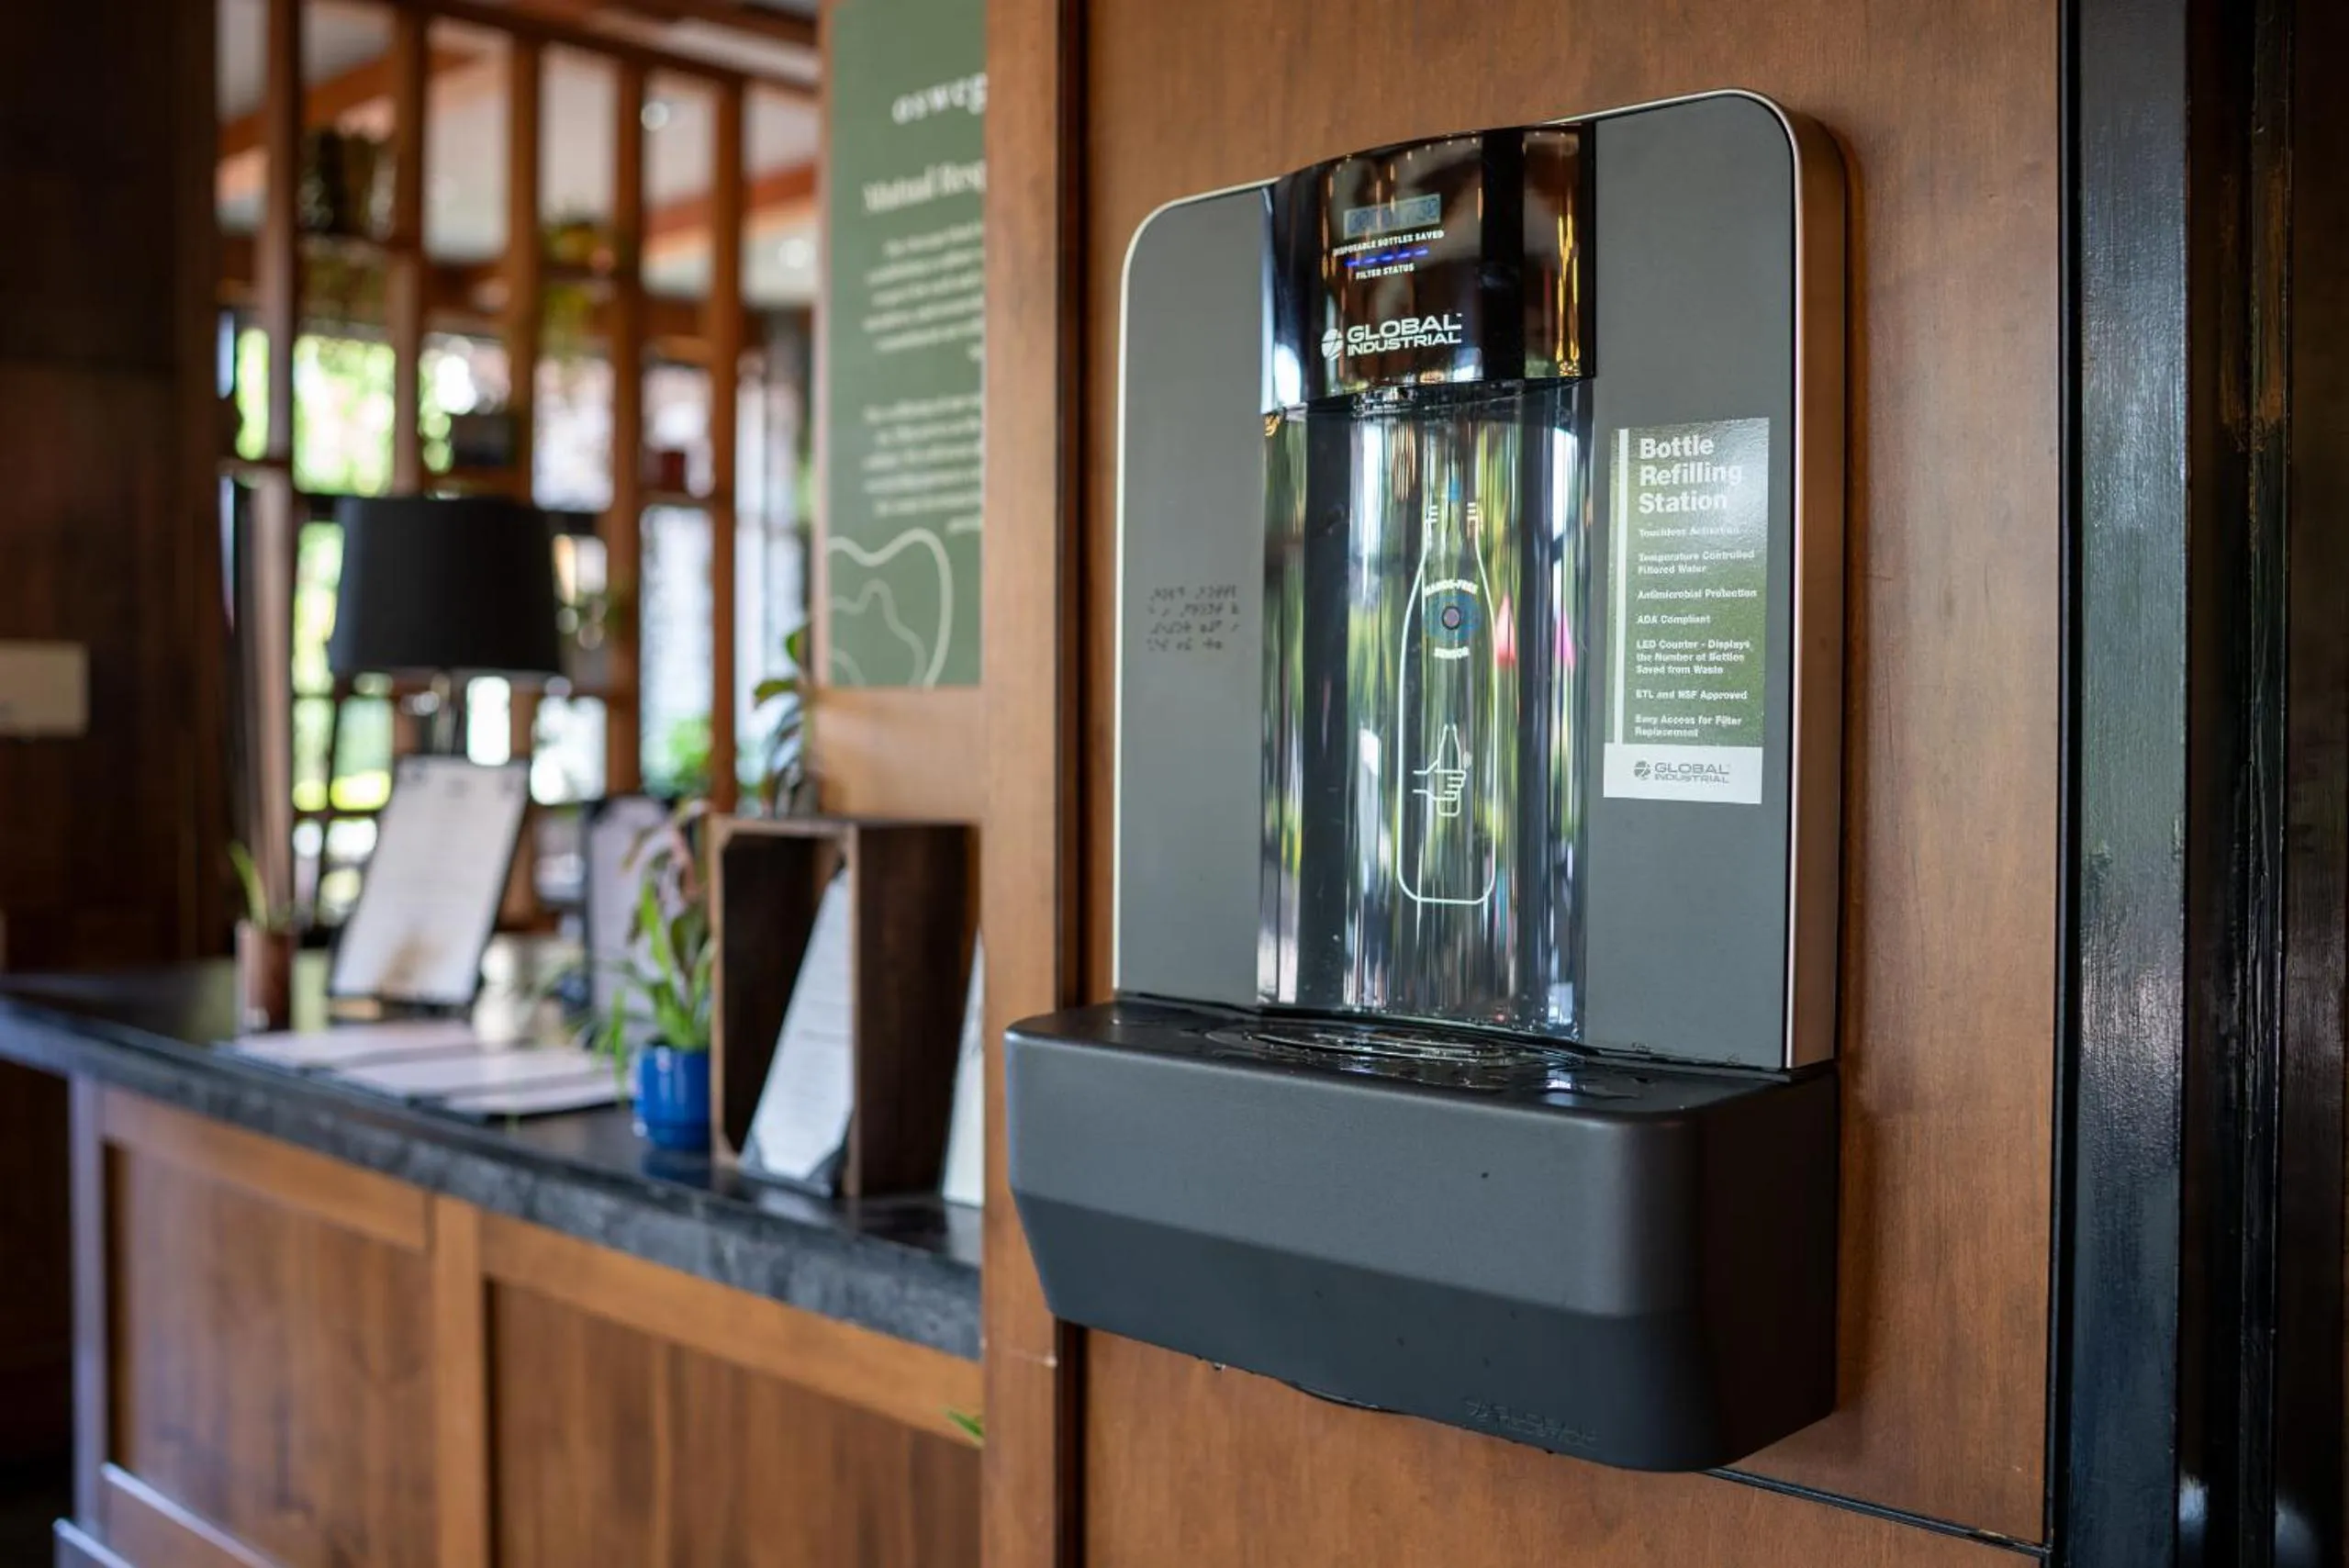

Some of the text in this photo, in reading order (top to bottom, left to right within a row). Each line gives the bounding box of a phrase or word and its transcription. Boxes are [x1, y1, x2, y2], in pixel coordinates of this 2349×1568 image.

[1378, 234, 1414, 248] BOTTLES
[1415, 229, 1445, 242] SAVED
[1355, 263, 1415, 281] FILTER STATUS
[1346, 313, 1462, 343] GLOBAL
[1347, 331, 1462, 356] INDUSTRIAL
[1639, 435, 1714, 459] Bottle
[1639, 462, 1742, 487] Refilling
[1639, 490, 1728, 514] Station
[1638, 549, 1755, 563] Temperature Controlled
[1638, 564, 1707, 575] Filtered Water
[1638, 588, 1757, 599] Antimicrobial Protection
[1638, 614, 1711, 625] ADA Compliant
[1636, 639, 1656, 649] LED
[1658, 639, 1698, 649] Counter
[1707, 639, 1751, 650] Displays
[1636, 652, 1745, 663] the Number of Bottles
[1635, 665, 1724, 675] Saved from Waste
[1636, 689, 1748, 702] ETL and NSF Approved
[1635, 714, 1742, 726] Easy Access for Filter
[1634, 727, 1699, 738] Replacement
[1654, 762, 1730, 775] GLOBAL
[1654, 773, 1730, 784] INDUSTRIAL
